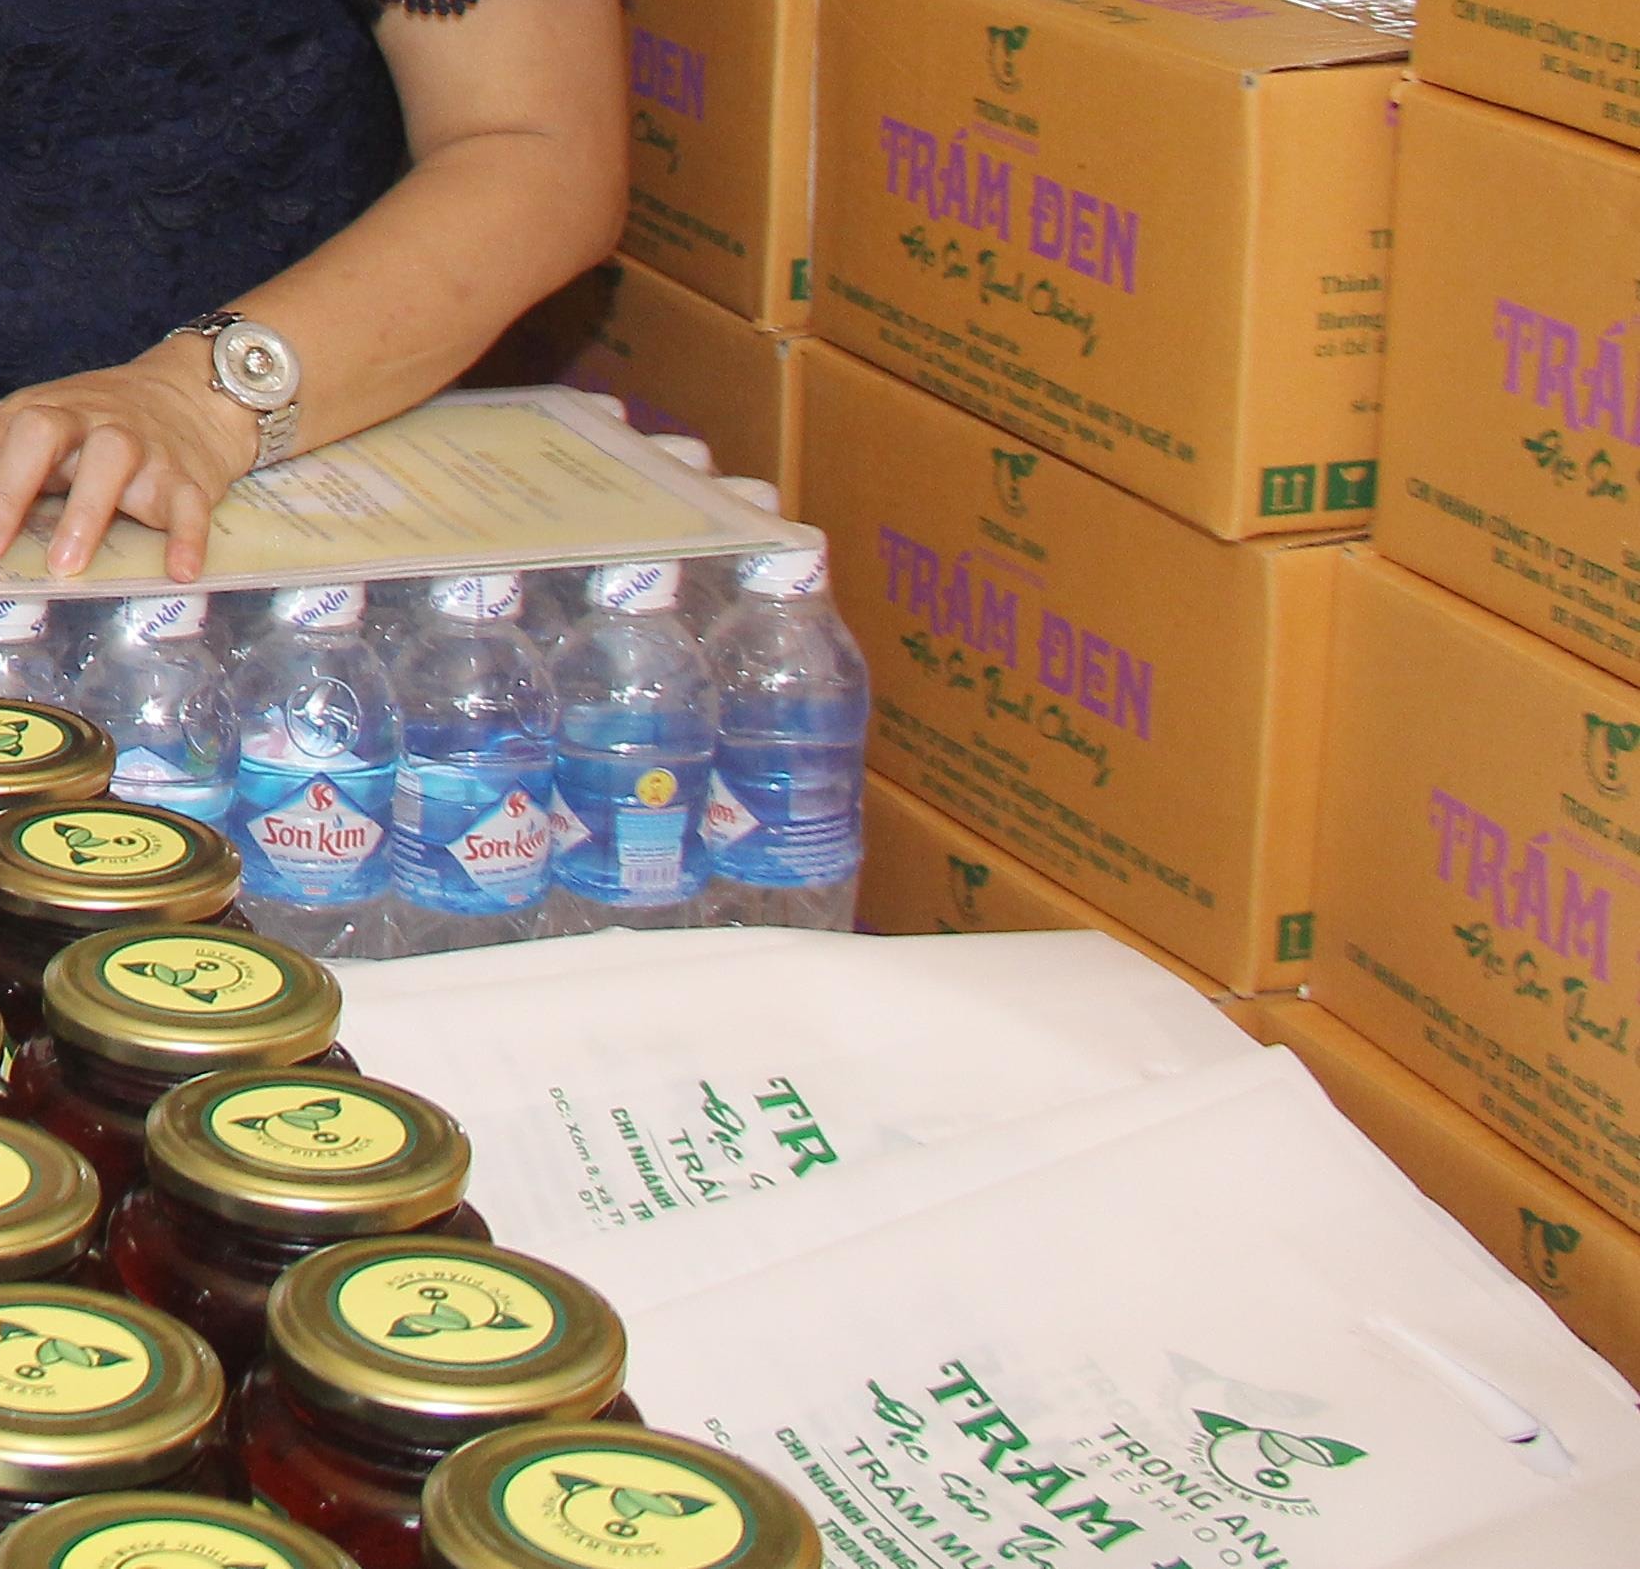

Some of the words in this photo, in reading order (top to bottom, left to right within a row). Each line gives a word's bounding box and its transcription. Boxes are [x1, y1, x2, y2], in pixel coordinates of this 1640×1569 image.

[631, 26, 707, 122] ĐEN
[880, 115, 1013, 244] TRÁM
[1029, 173, 1141, 295] ĐEN
[1493, 295, 1640, 449] TRÁ
[878, 522, 1019, 671] TRÁM
[1037, 607, 1155, 742] ĐEN
[317, 813, 367, 858] kim
[1430, 784, 1617, 985] TRÁM
[610, 1107, 639, 1141] CHI
[627, 1145, 679, 1211] NHÁNH
[753, 1077, 840, 1178] TR
[775, 1425, 812, 1463] CHI
[802, 1461, 871, 1528] NHÁNH
[843, 1435, 939, 1532] TRÁM
[926, 1358, 1146, 1553] TRÁM
[1100, 1421, 1223, 1512] TRỌNG
